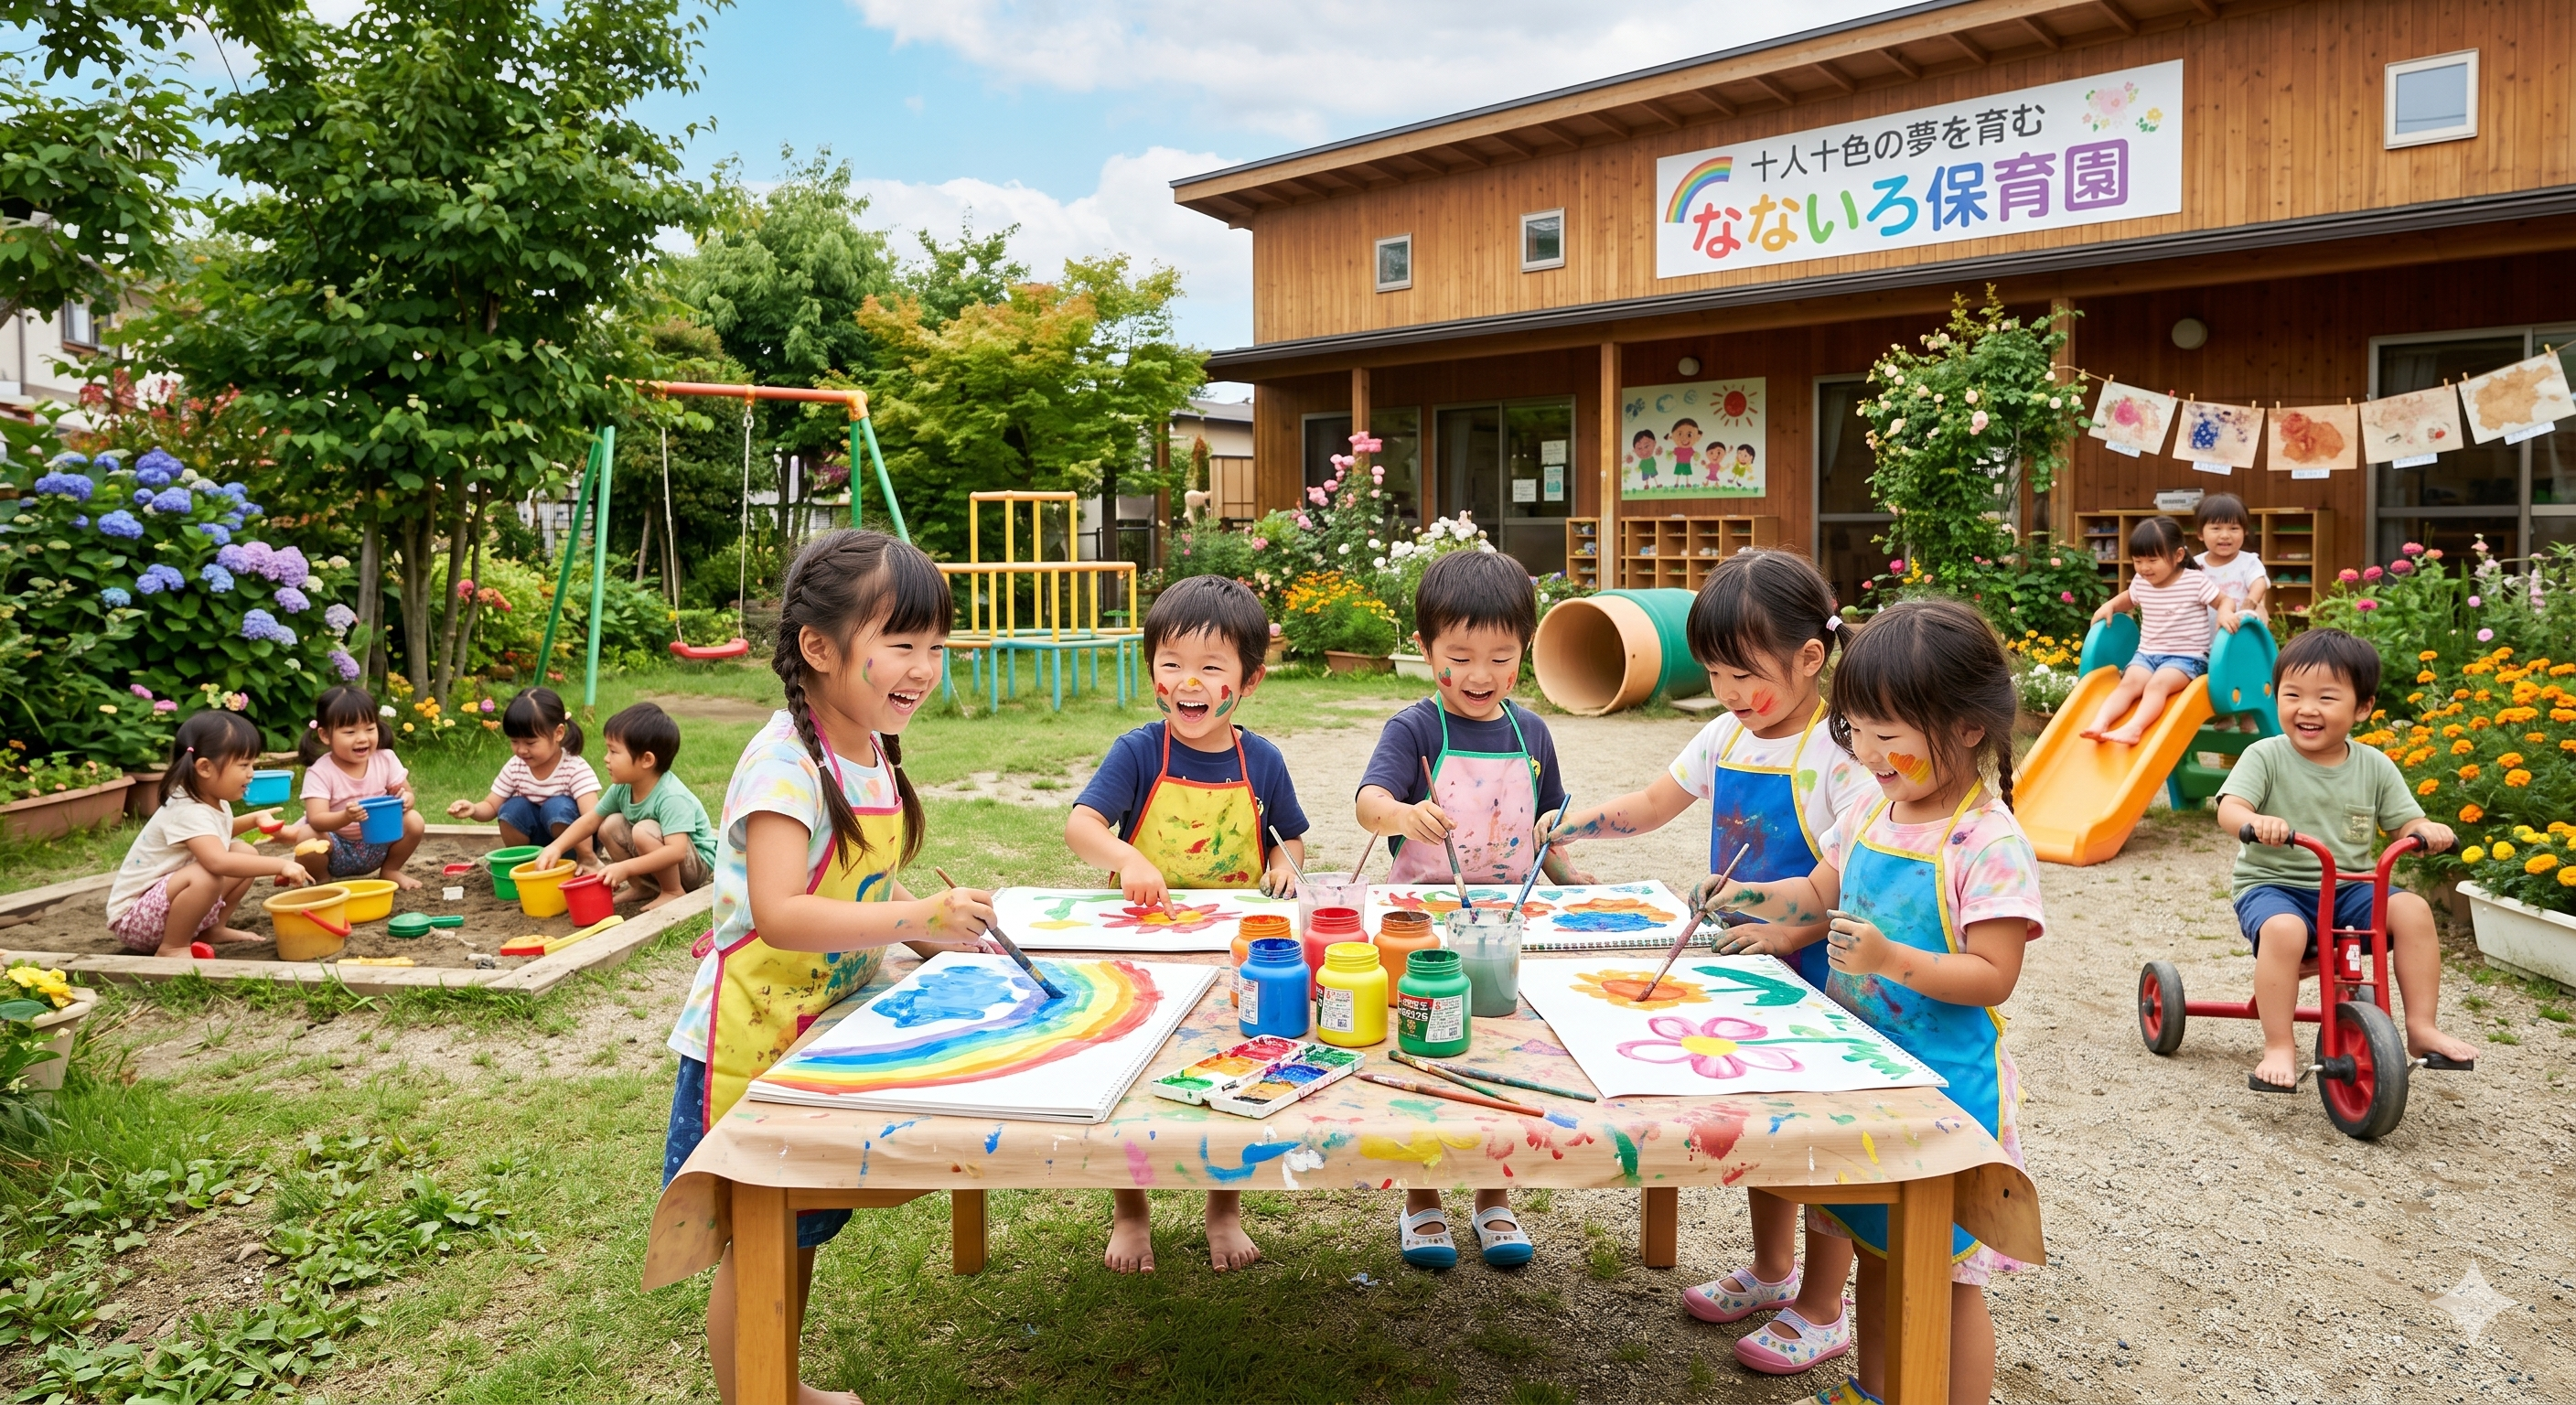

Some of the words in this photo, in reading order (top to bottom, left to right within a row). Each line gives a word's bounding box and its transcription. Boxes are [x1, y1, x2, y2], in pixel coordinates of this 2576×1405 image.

[1750, 102, 2045, 183] 十人十色の夢を育む
[1691, 138, 2130, 260] なないろ保育園
